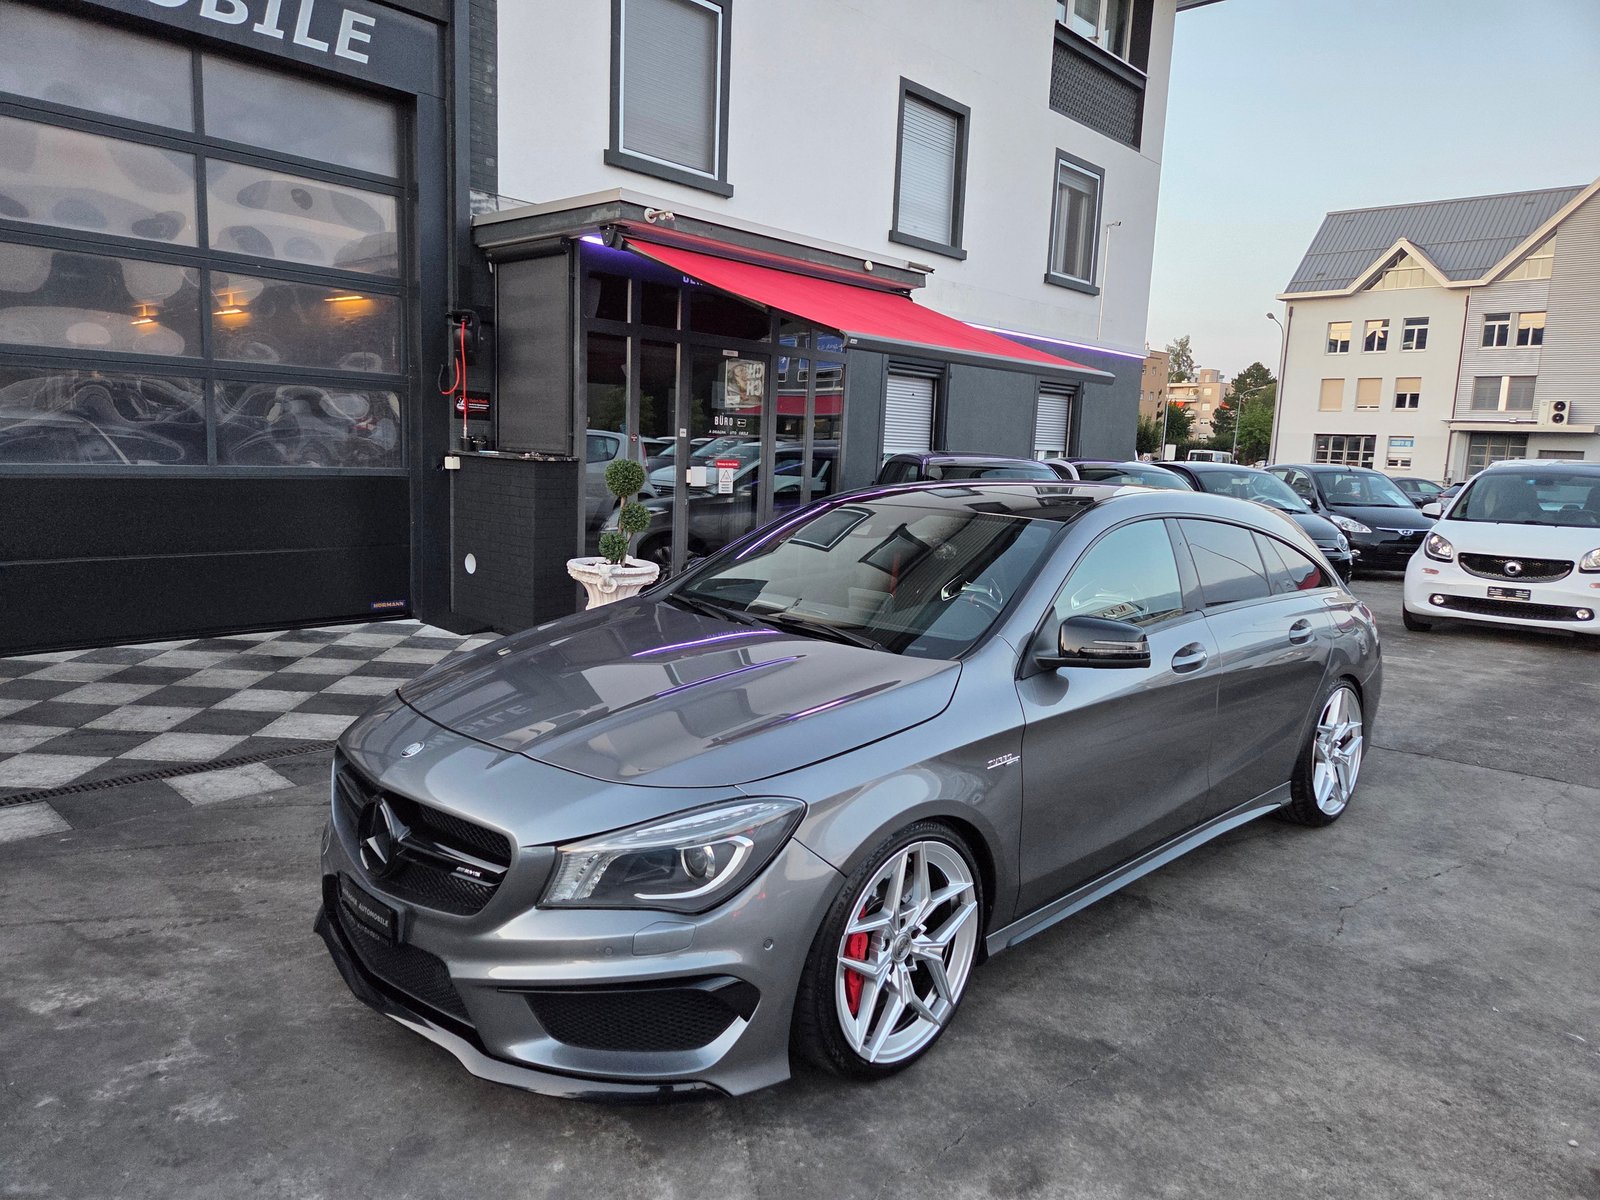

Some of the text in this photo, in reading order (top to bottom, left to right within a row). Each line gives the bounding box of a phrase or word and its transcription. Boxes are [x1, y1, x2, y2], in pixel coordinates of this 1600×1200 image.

[147, 0, 376, 65] ILE
[714, 412, 734, 426] BÜRO
[358, 903, 389, 928] AUTOMOBILE
